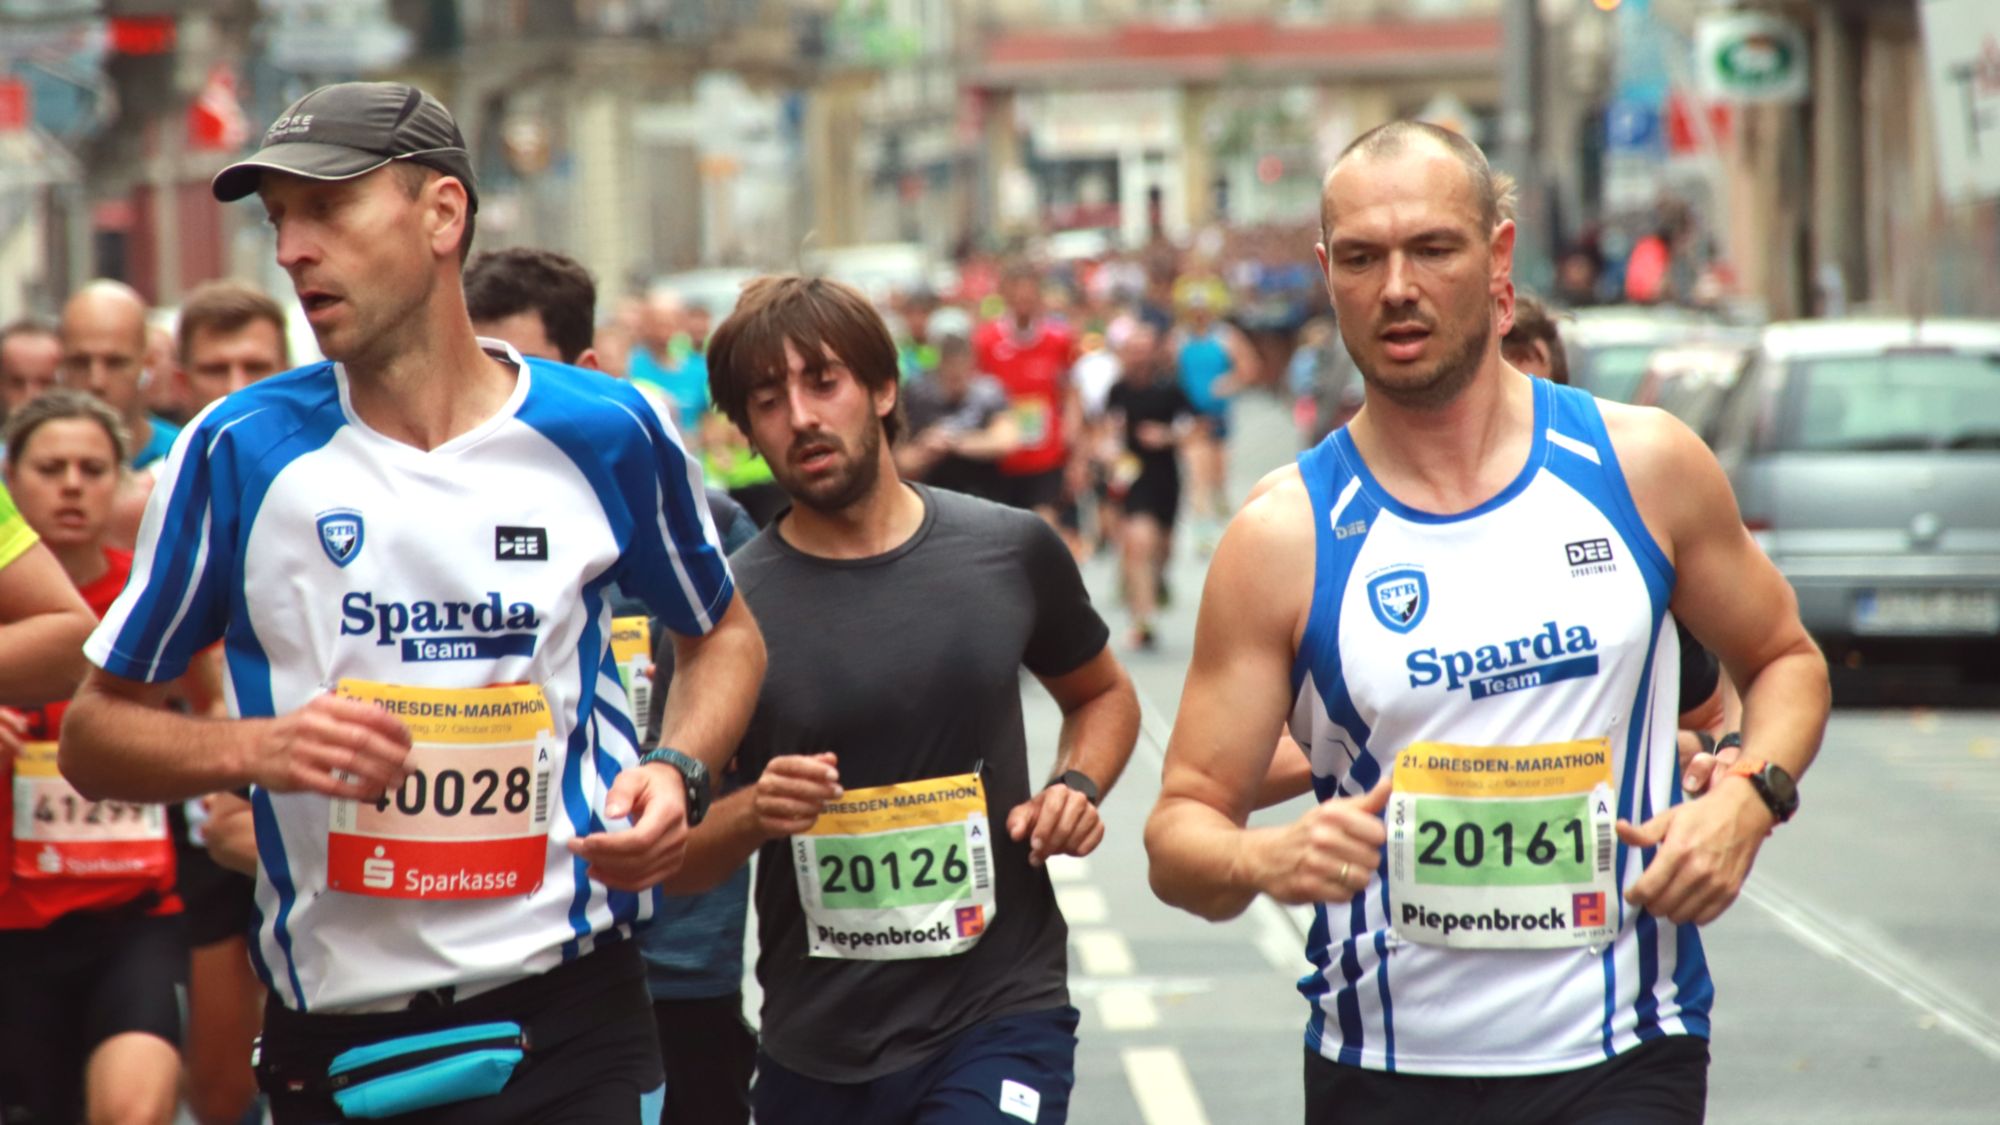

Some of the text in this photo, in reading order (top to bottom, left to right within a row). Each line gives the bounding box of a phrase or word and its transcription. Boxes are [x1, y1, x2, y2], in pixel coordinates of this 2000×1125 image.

[326, 525, 355, 537] STR
[1335, 520, 1366, 540] DEE
[1567, 540, 1611, 565] DEE
[1380, 582, 1417, 601] STR
[340, 592, 540, 646] Sparda
[413, 640, 476, 659] Team
[1406, 620, 1597, 692] Sparda
[1480, 671, 1541, 696] Team
[538, 747, 549, 761] A
[1402, 751, 1605, 773] 21. DRESDEN-MARATHON
[1597, 801, 1608, 814] A
[971, 824, 982, 837] A
[1417, 818, 1585, 867] 20161
[820, 843, 968, 894] 20126
[405, 868, 518, 897] Sparkasse
[1401, 902, 1566, 936] Piepenbrock
[817, 921, 952, 950] Piepenbrock
